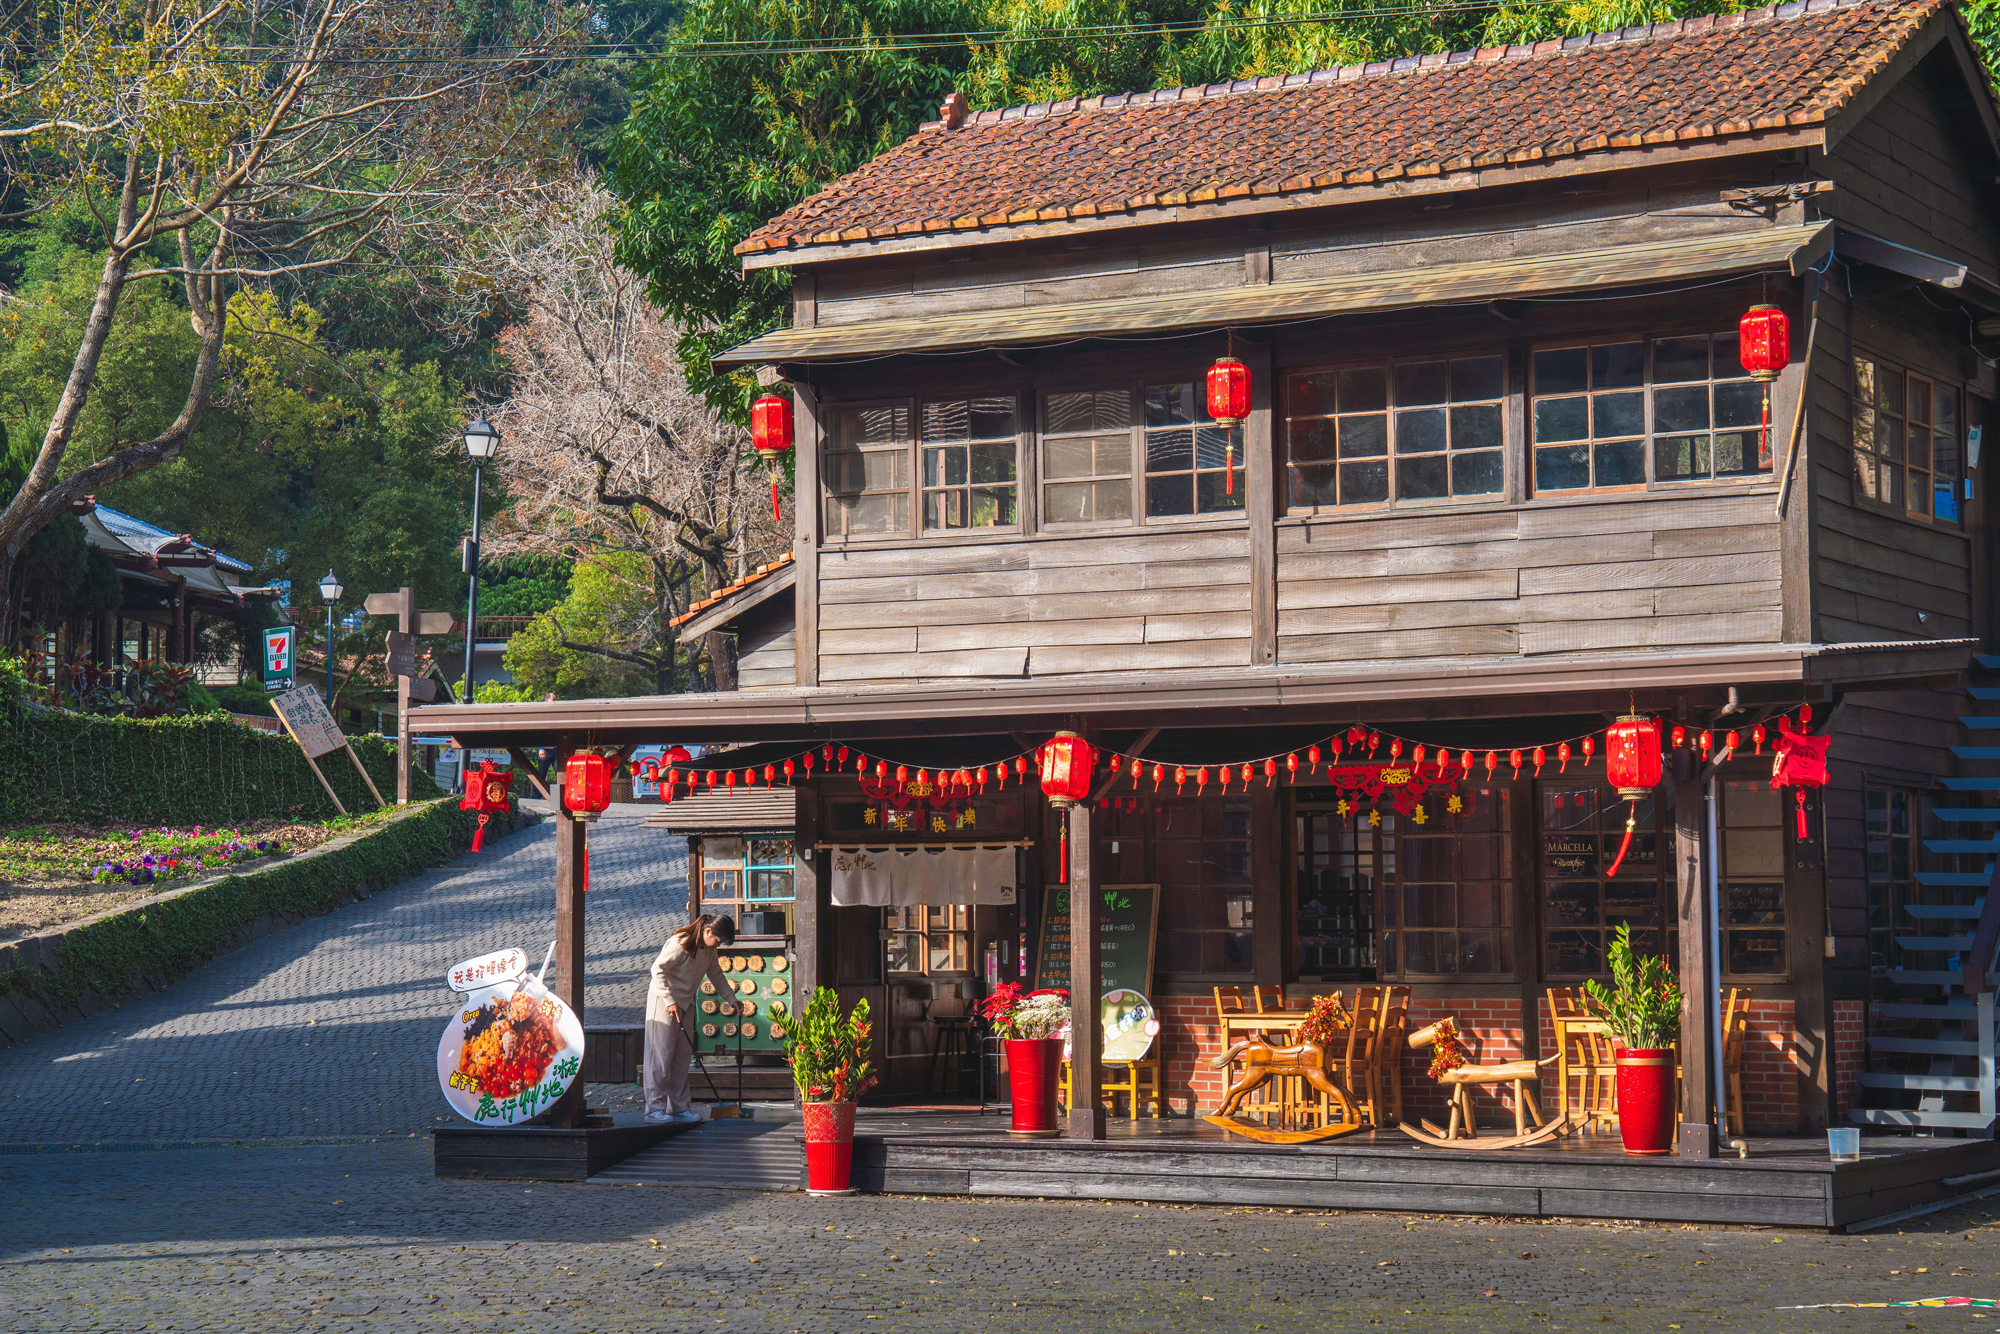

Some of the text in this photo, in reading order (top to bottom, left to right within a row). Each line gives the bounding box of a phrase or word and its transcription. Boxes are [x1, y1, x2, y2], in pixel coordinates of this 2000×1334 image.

[863, 807, 976, 833] 新年快樂
[1336, 794, 1463, 827] 平安喜樂
[1548, 842, 1593, 852] MARCELLA
[462, 1009, 480, 1024] Oreo
